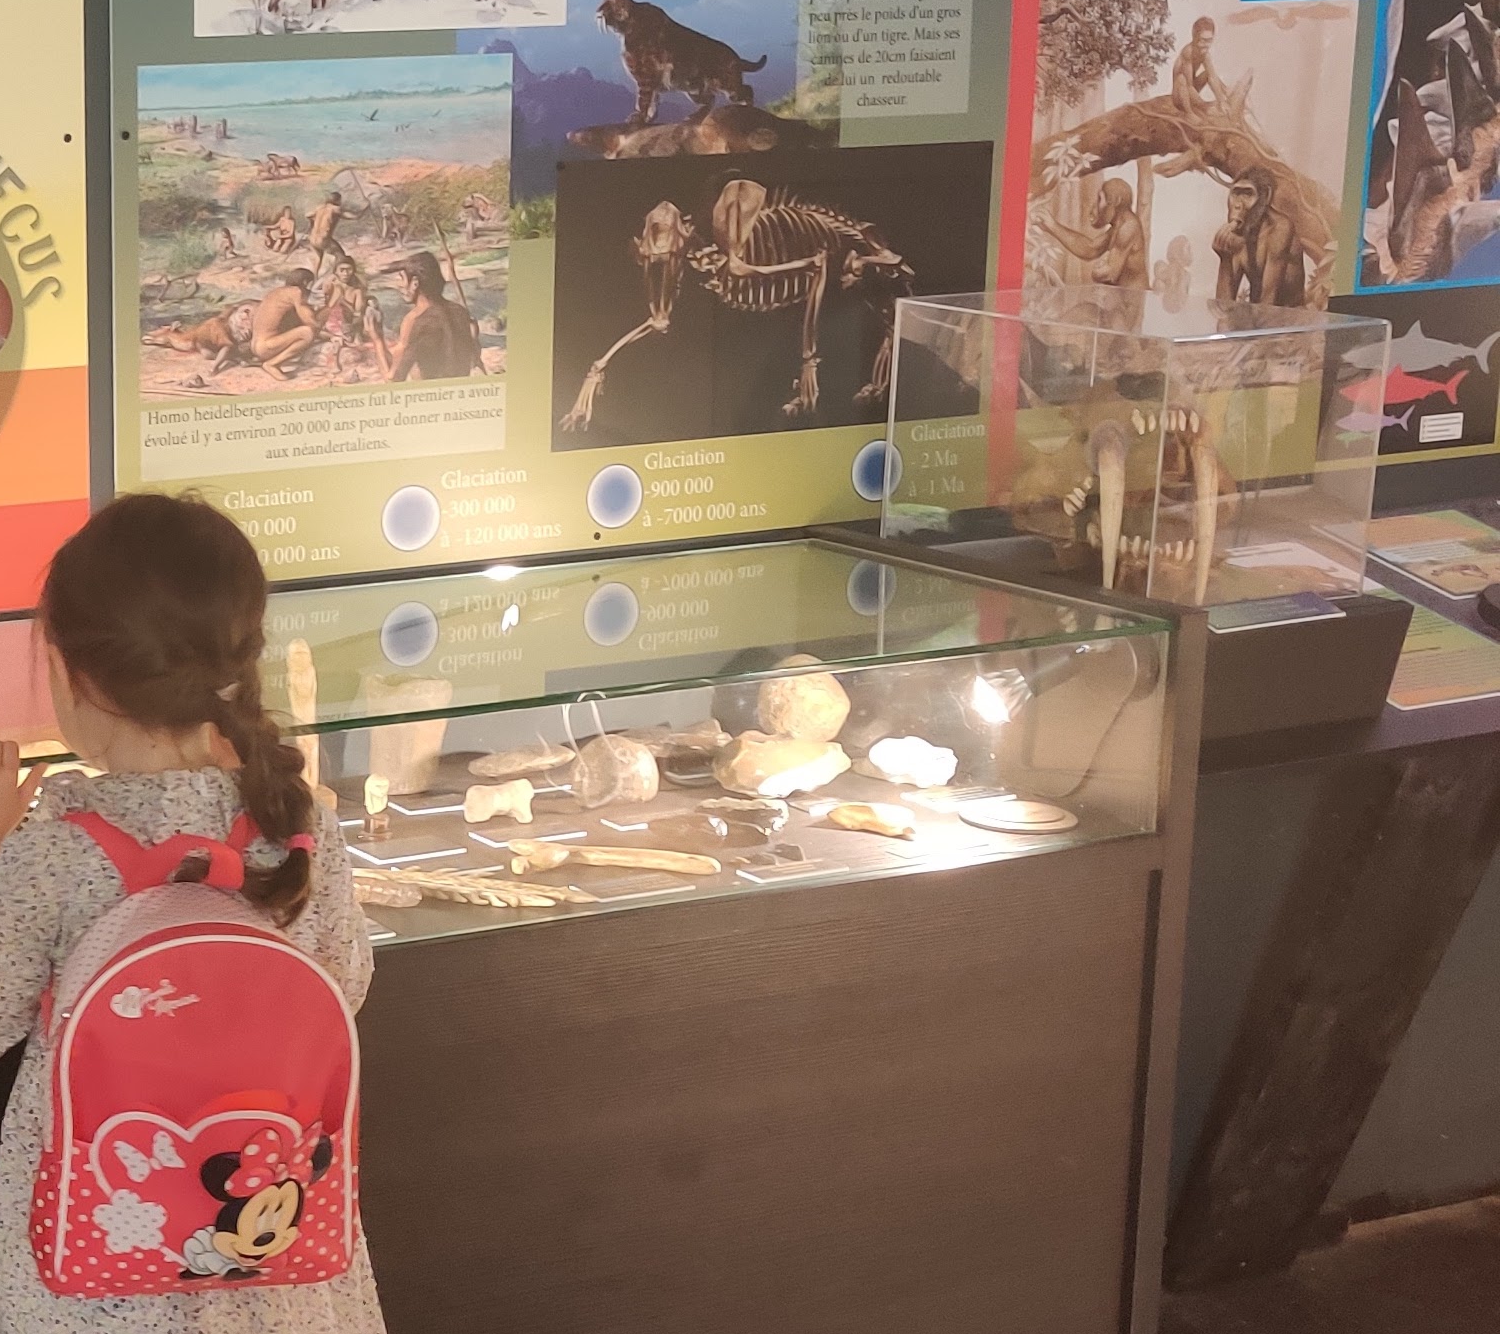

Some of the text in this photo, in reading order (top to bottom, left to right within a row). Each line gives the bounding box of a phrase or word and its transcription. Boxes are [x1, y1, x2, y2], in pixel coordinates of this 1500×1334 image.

[148, 385, 501, 426] Homo heidelbergensis européens fut le premier a avoir
[644, 449, 725, 471] Glaciation
[441, 468, 527, 489] Glaciation
[644, 476, 714, 498] -900 000
[224, 488, 314, 510] Glaciation
[642, 502, 767, 527] à -7000 000 ans
